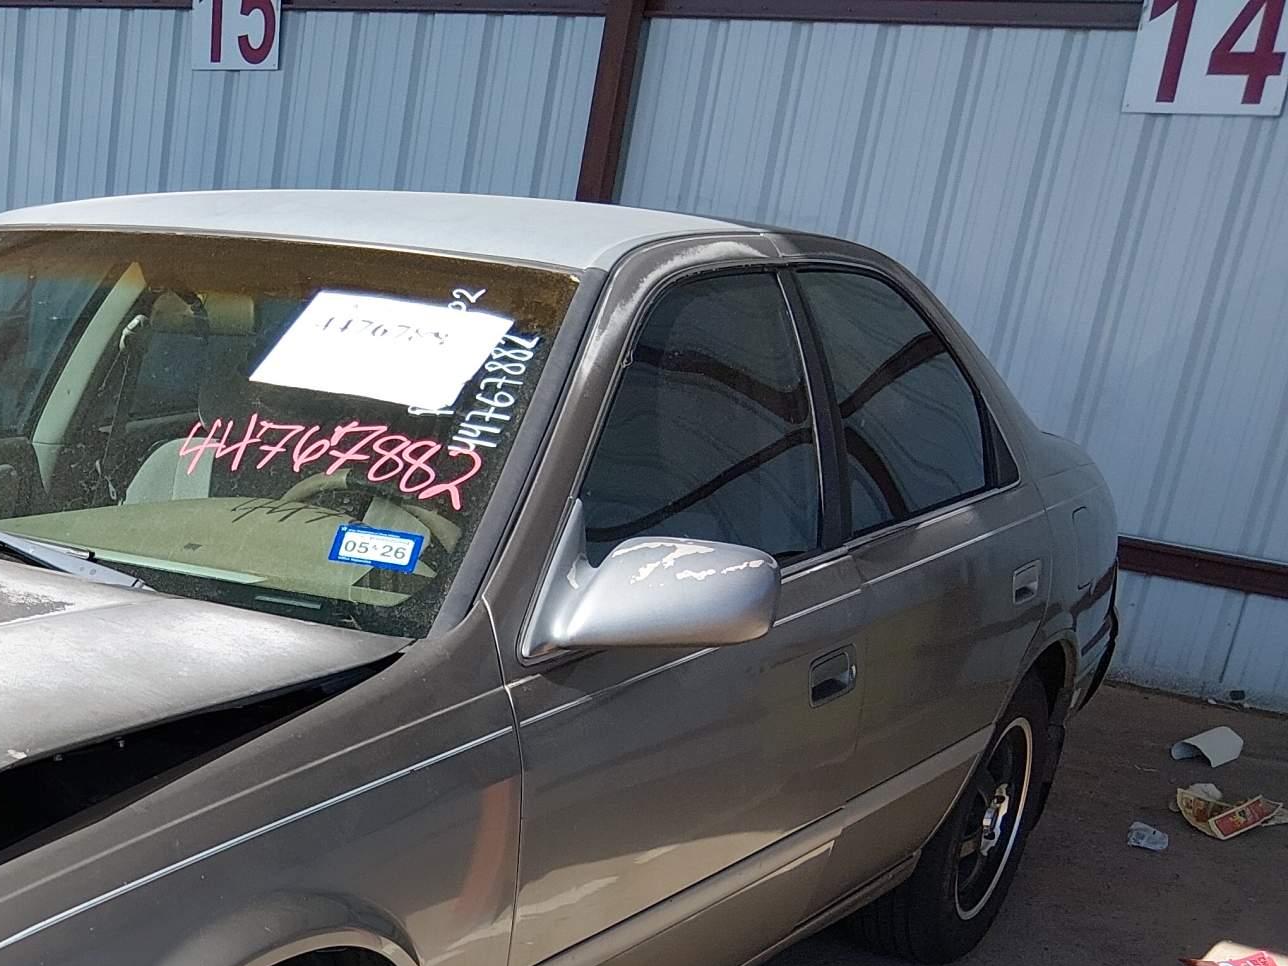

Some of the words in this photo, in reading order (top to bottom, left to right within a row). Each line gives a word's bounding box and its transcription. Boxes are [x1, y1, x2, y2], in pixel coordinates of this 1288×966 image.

[210, 0, 276, 64] 15
[1149, 0, 1287, 104] 14
[179, 413, 482, 511] 44767882
